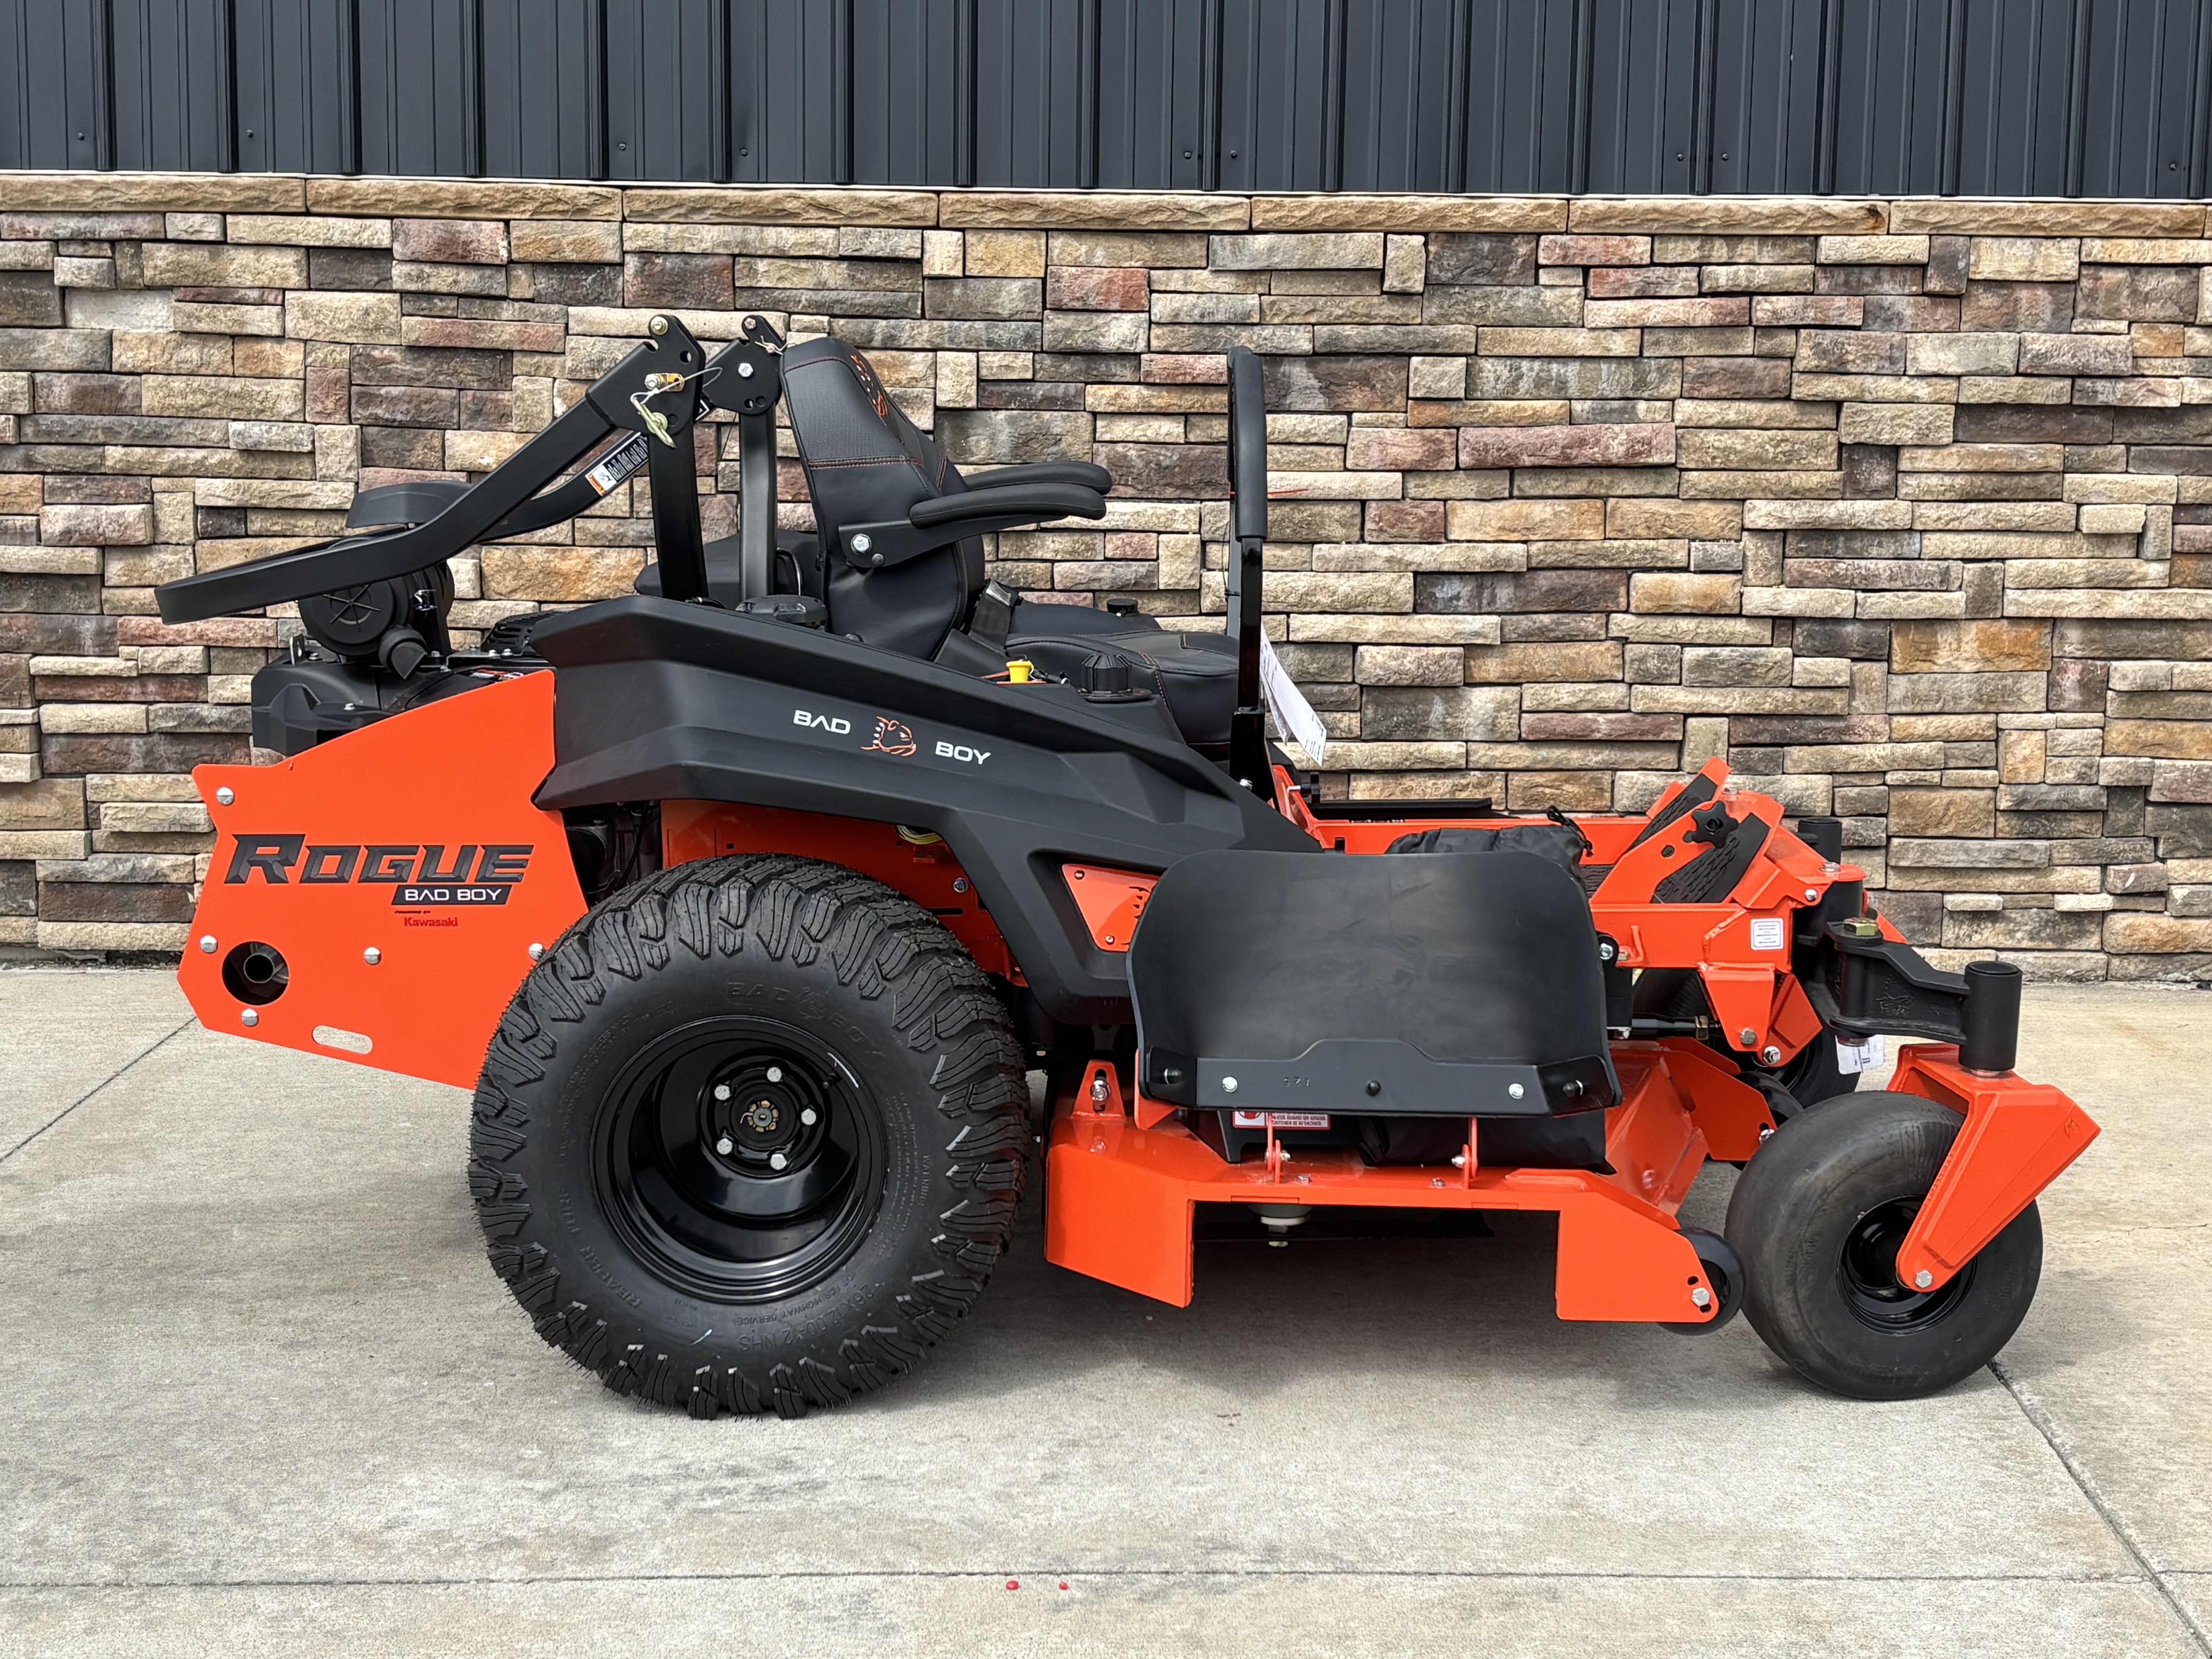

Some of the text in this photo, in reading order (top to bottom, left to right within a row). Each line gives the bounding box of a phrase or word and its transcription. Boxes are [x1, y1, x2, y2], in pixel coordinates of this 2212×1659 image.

[793, 709, 991, 765] BAD BOY
[224, 834, 533, 884] ROGUE
[405, 889, 501, 901] BAD BOY
[404, 917, 458, 926] Kawasaki
[780, 1296, 823, 1319] HIGHWAY
[736, 1313, 777, 1324] SERVICE
[738, 1333, 777, 1351] NHS
